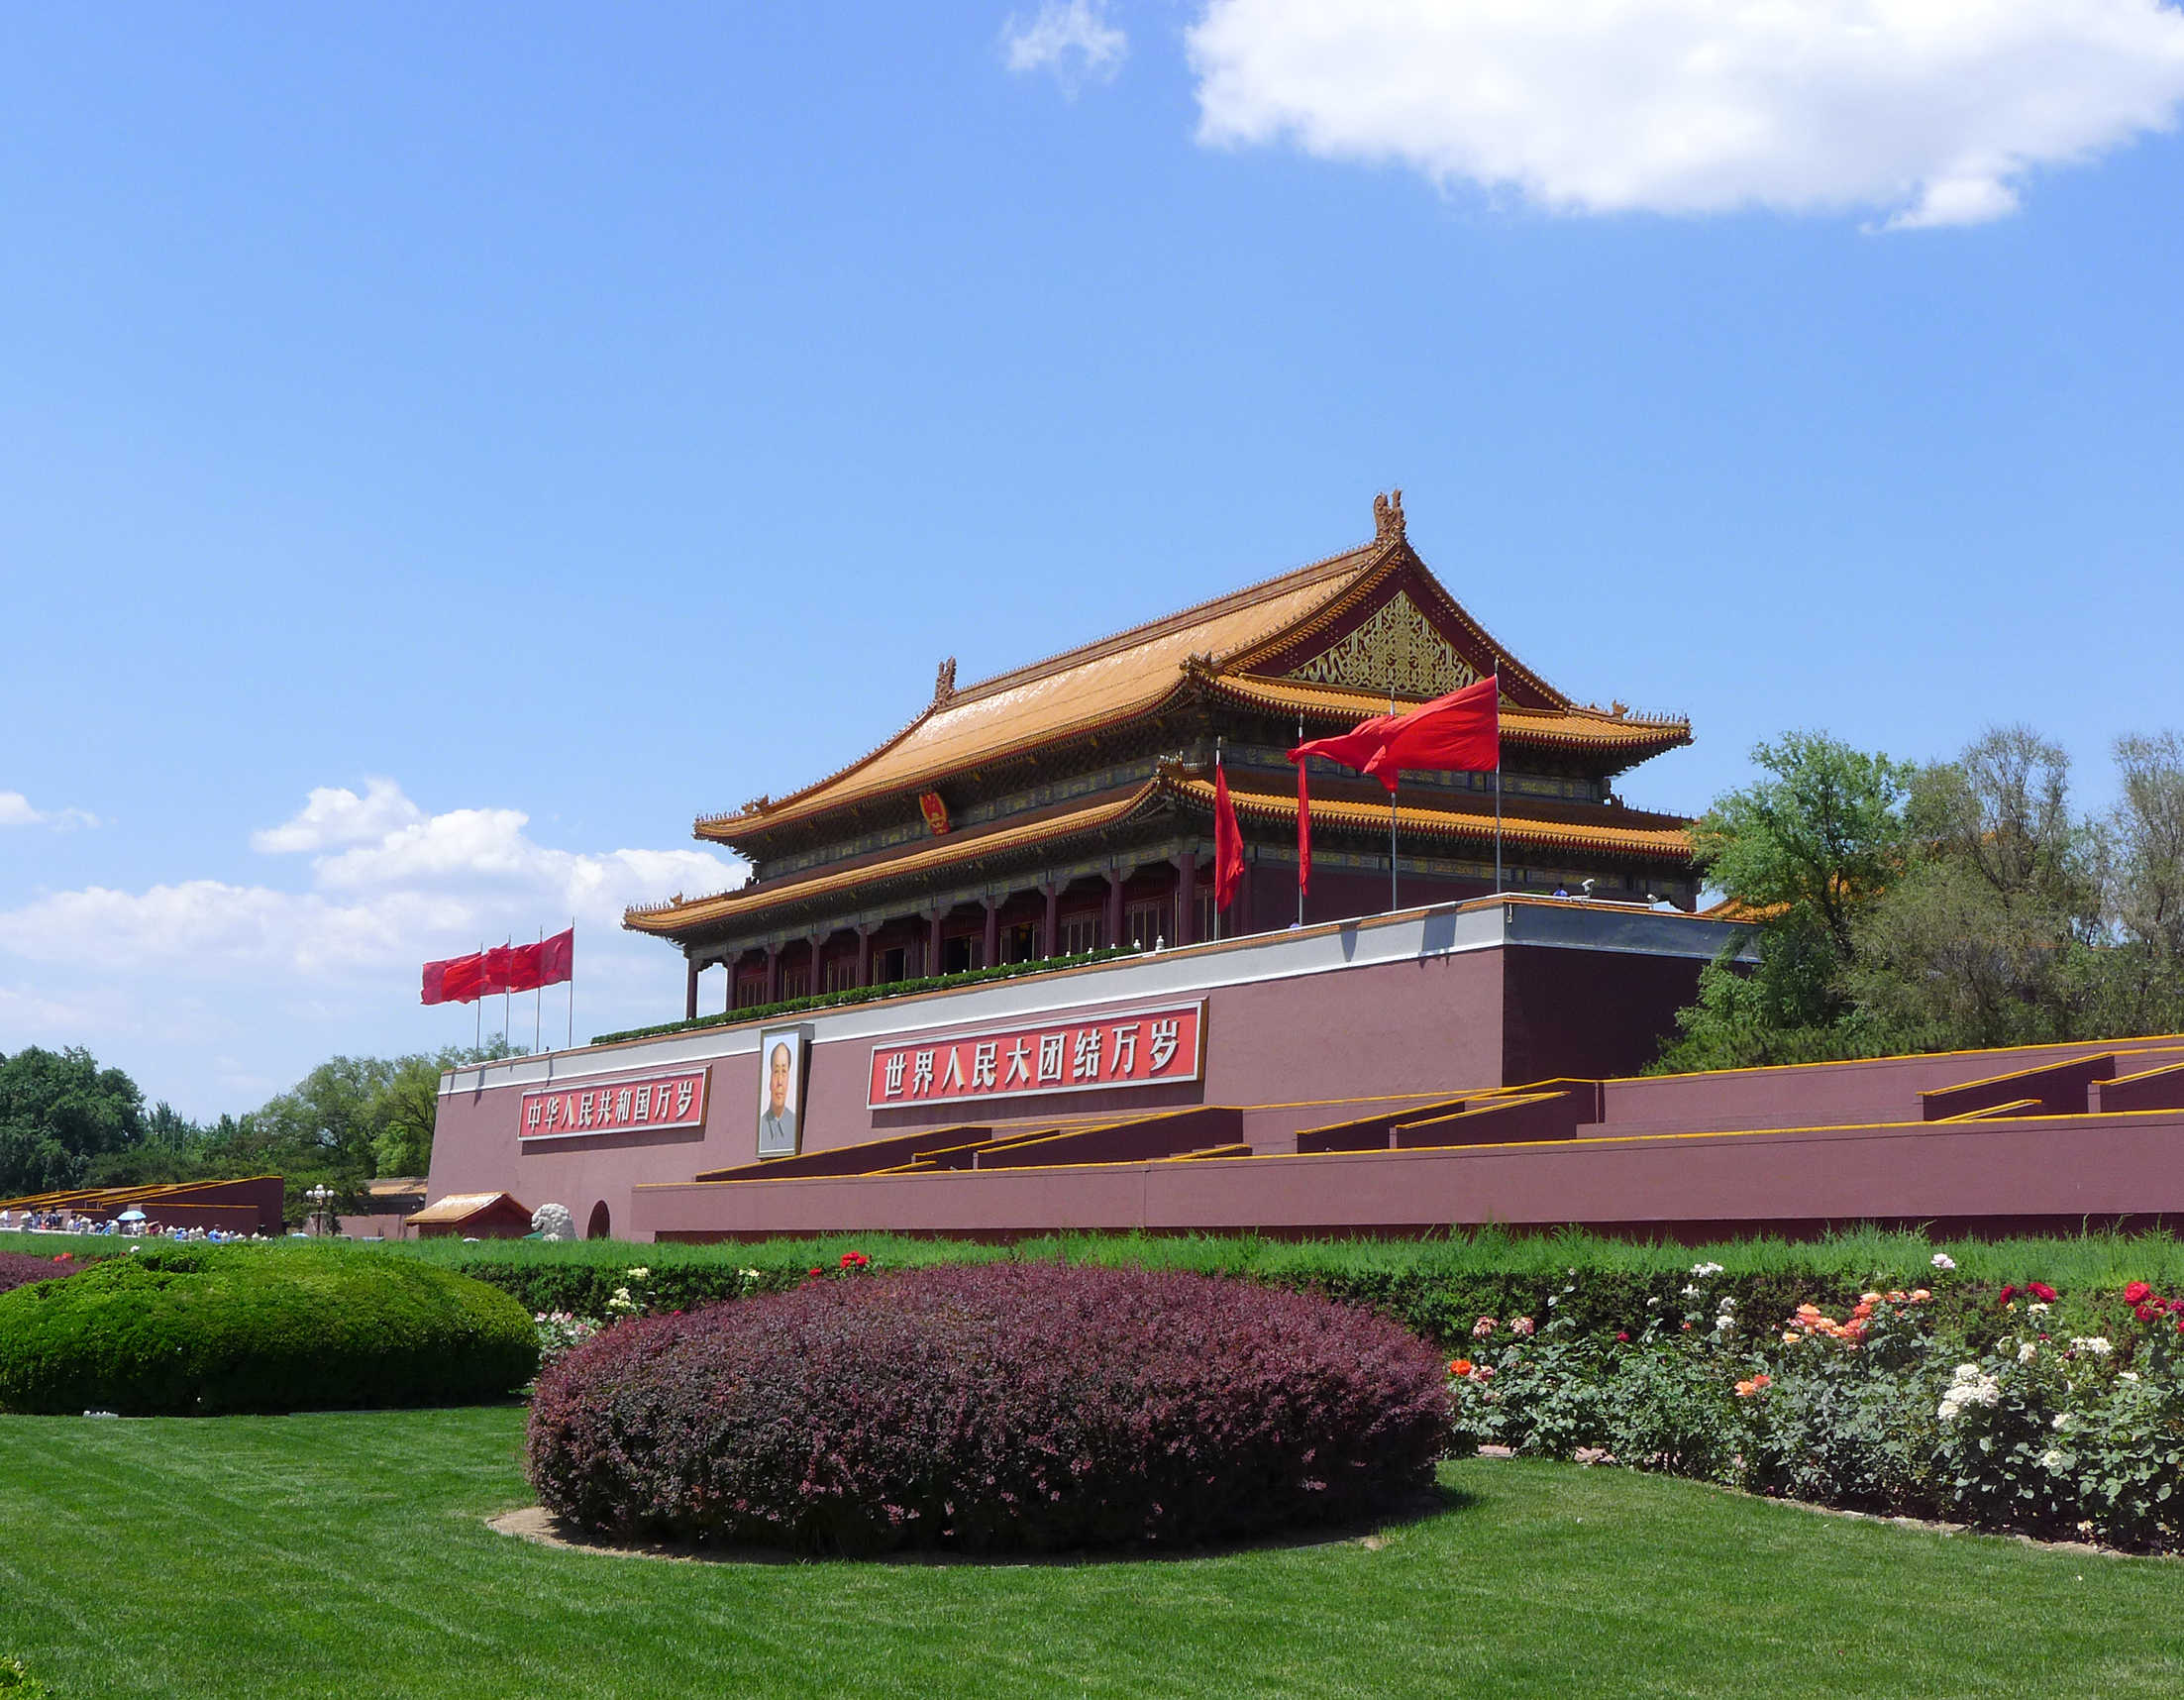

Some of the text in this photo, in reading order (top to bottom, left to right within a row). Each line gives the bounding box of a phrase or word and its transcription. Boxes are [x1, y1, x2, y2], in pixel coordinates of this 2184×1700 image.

[884, 1018, 1179, 1097] 世界人民大团结万岁
[527, 1081, 694, 1130] 中华人民共和国万岁
